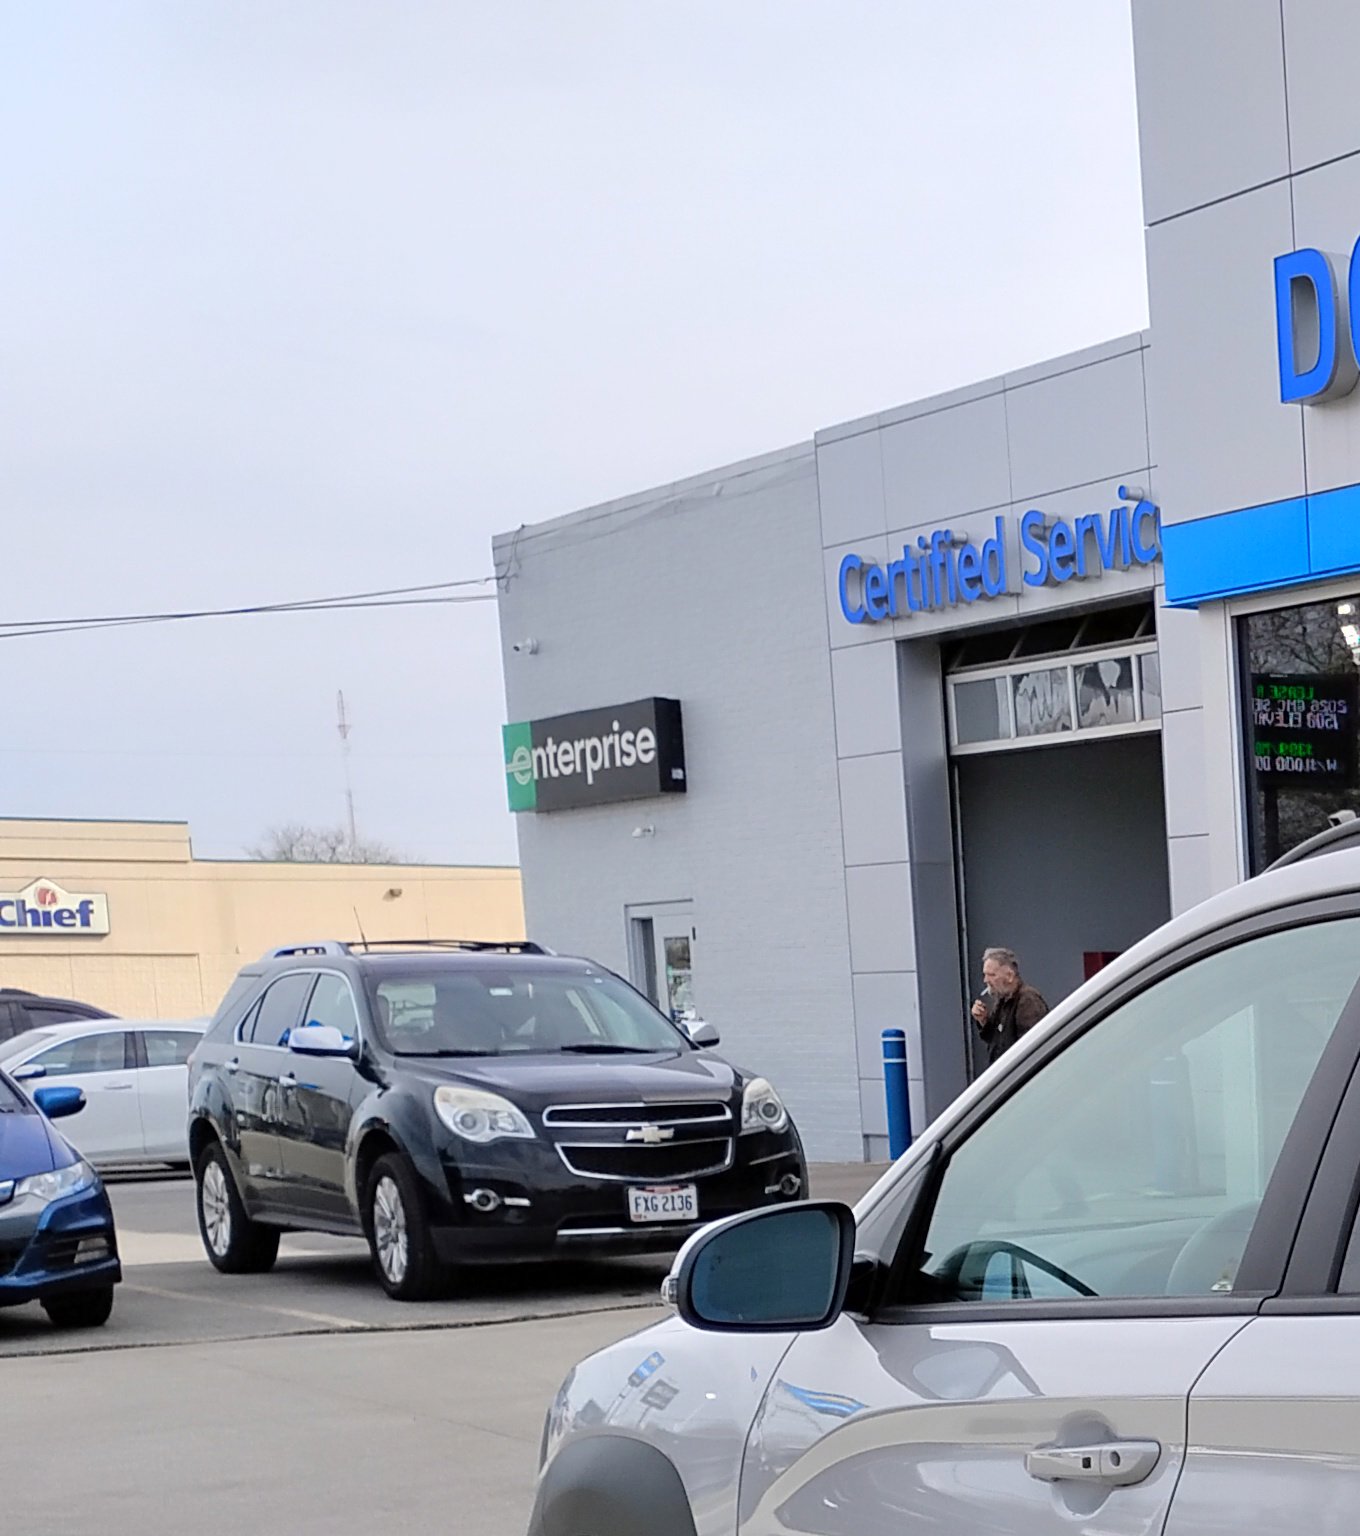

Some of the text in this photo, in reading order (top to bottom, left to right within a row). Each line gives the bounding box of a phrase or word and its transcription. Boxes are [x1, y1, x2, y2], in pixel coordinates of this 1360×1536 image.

[838, 484, 1162, 624] Certified Servic
[506, 720, 657, 785] enterprise
[0, 899, 94, 928] Chief
[634, 1195, 693, 1213] FXG 2136
